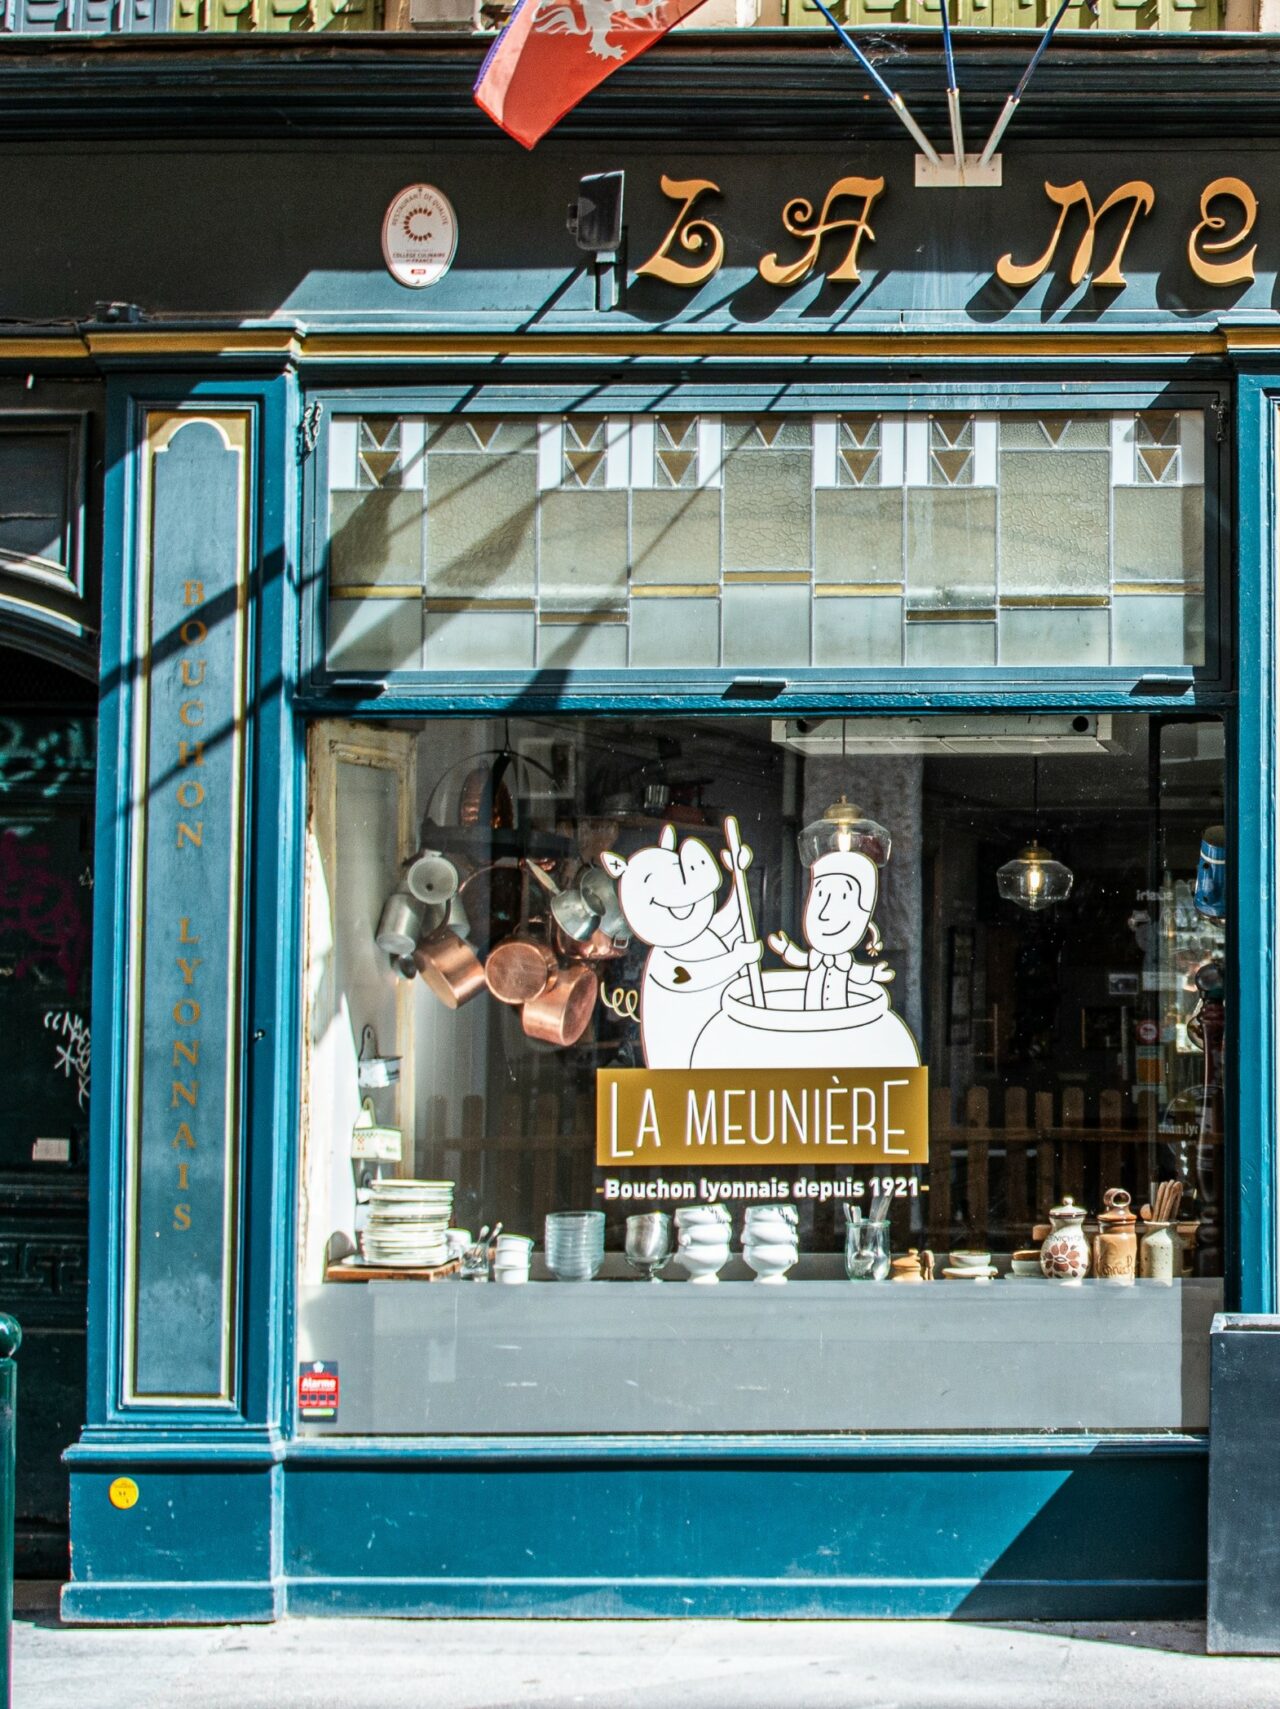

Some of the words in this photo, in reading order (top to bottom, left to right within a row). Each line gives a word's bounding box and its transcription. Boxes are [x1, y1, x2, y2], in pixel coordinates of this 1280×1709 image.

[635, 174, 886, 288] LA
[176, 580, 208, 849] BOUCHON
[171, 918, 202, 1232] LYONNAIS
[611, 1082, 662, 1158] LA
[685, 1075, 910, 1155] MEUNIÈRE
[604, 1178, 696, 1199] Bouchon
[700, 1177, 789, 1202] lyonnais
[793, 1176, 865, 1200] depuis
[868, 1176, 919, 1197] 1921
